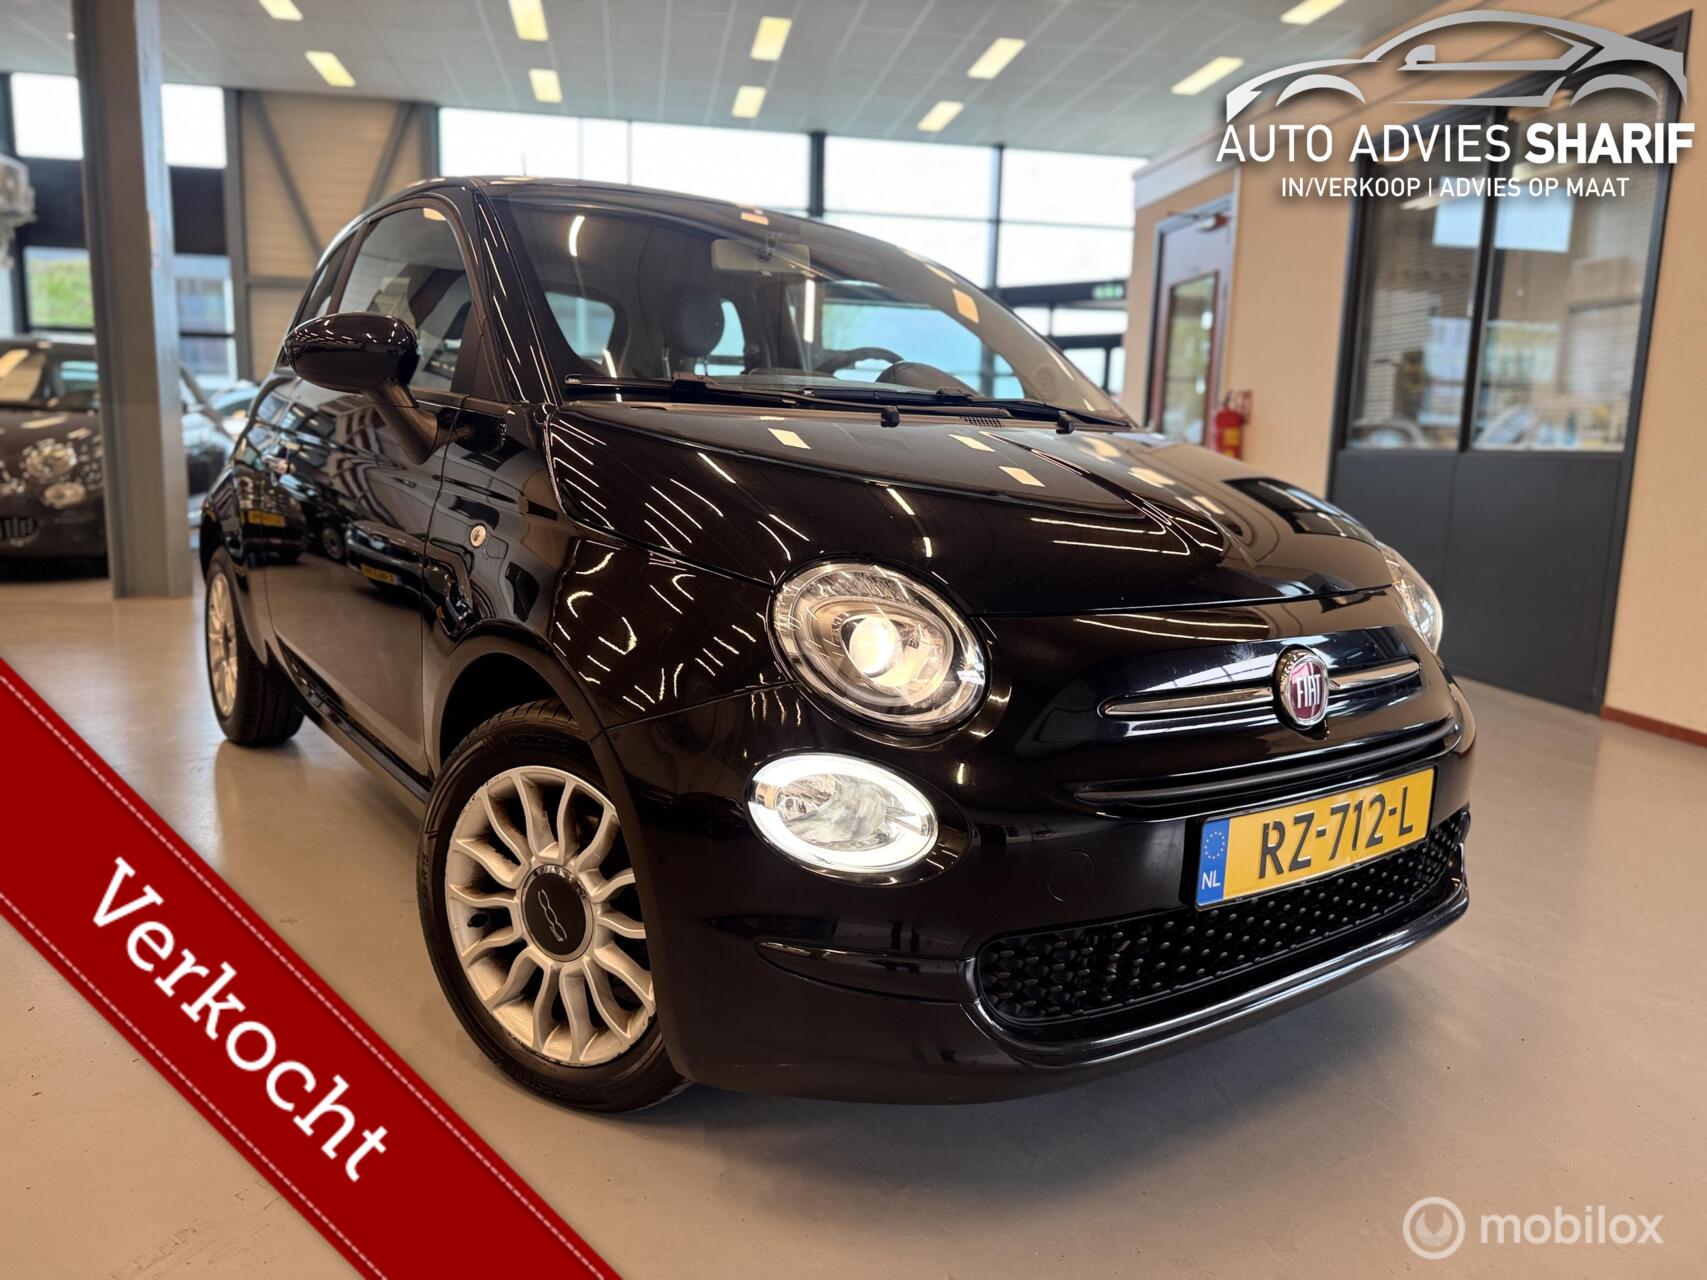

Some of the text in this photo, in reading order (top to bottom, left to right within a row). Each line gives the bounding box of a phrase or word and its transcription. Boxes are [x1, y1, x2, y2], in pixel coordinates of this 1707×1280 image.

[1296, 674, 1321, 709] FIAT
[1259, 786, 1414, 880] RZ-712-L
[1201, 870, 1221, 890] NL
